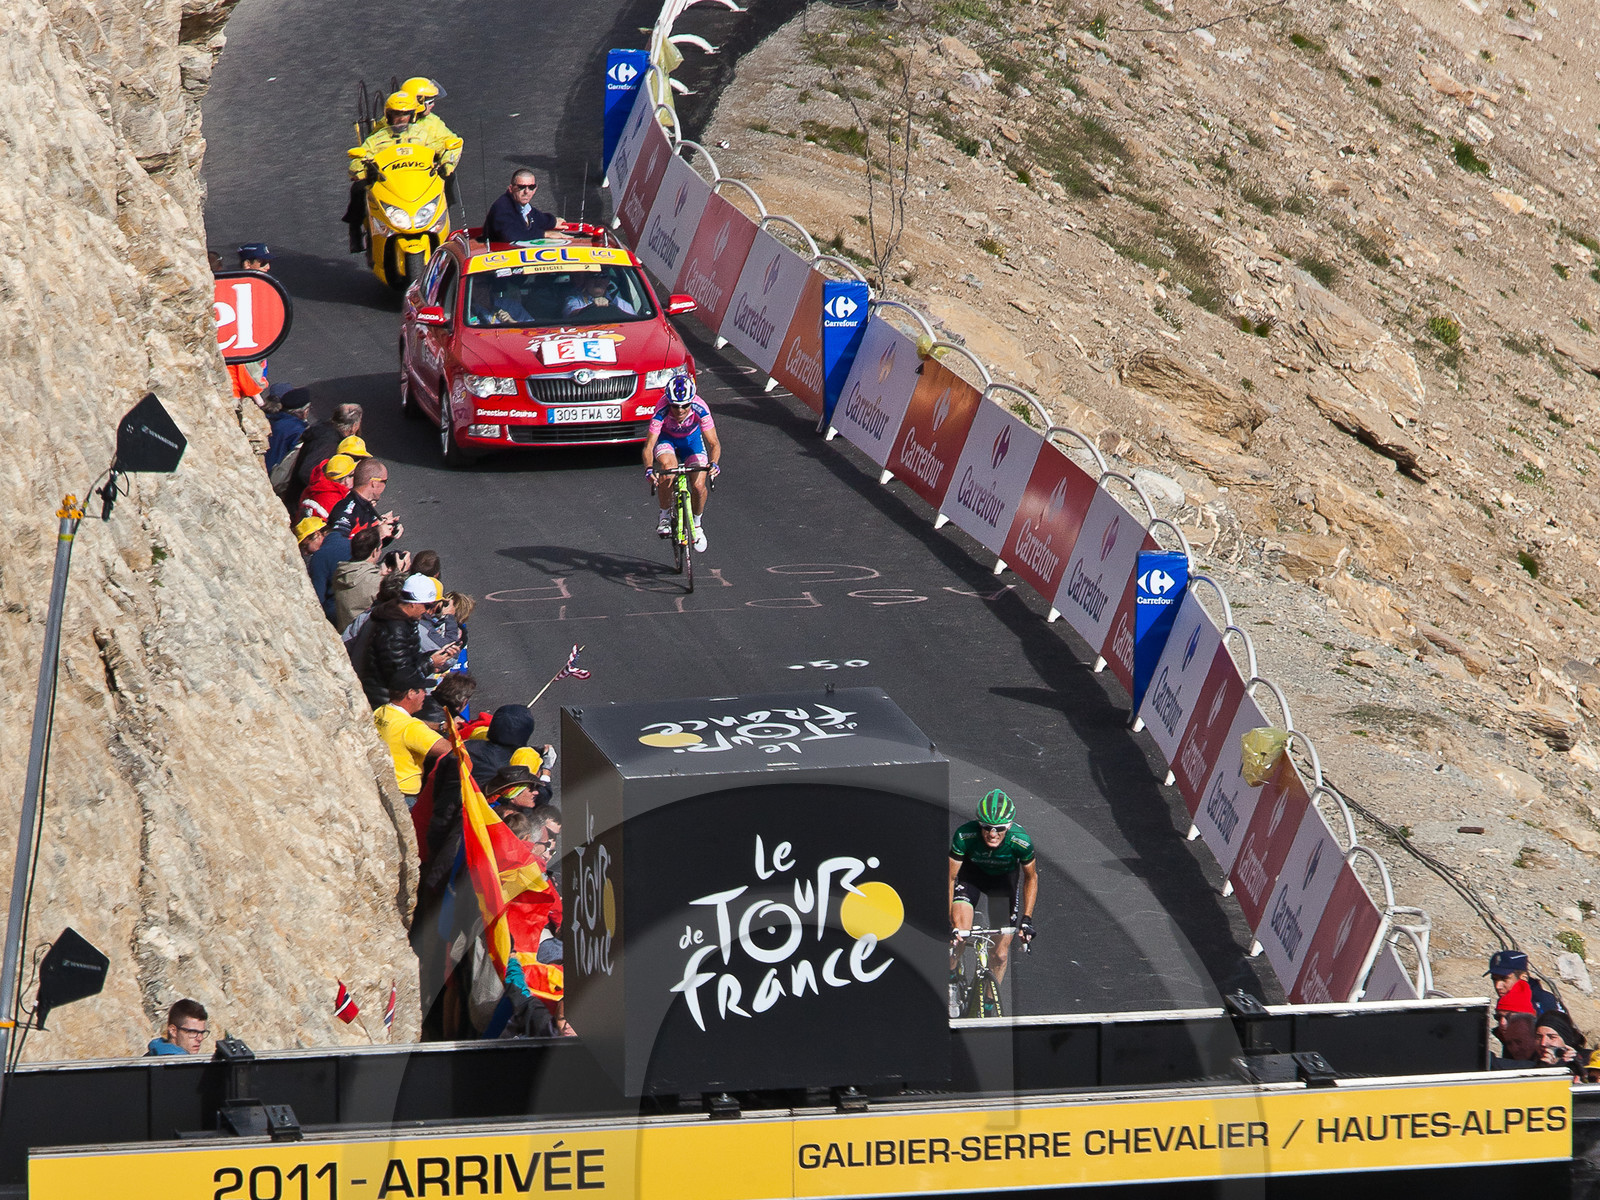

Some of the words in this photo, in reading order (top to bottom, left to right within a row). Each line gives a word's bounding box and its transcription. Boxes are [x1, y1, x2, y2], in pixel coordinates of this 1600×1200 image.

[391, 160, 425, 171] MAVIC
[520, 248, 580, 264] LCL
[734, 292, 776, 350] Carrefour
[824, 319, 858, 328] Carrefour
[785, 336, 823, 395] Carrefou
[477, 409, 508, 418] Direction
[509, 409, 538, 419] Course
[556, 408, 578, 421] 309
[581, 407, 604, 420] FWA
[606, 406, 620, 419] 92
[845, 380, 890, 441] Carrefour
[900, 426, 945, 489] Carrefour
[957, 465, 1005, 528] Carrefour
[1015, 518, 1060, 584] Carrefour
[1067, 557, 1110, 624] Carrefour
[797, 1131, 1071, 1171] GALIBIER-SERRE
[1083, 1121, 1270, 1157] CHEVALIER
[1315, 1105, 1568, 1145] HAUTES-ALPES
